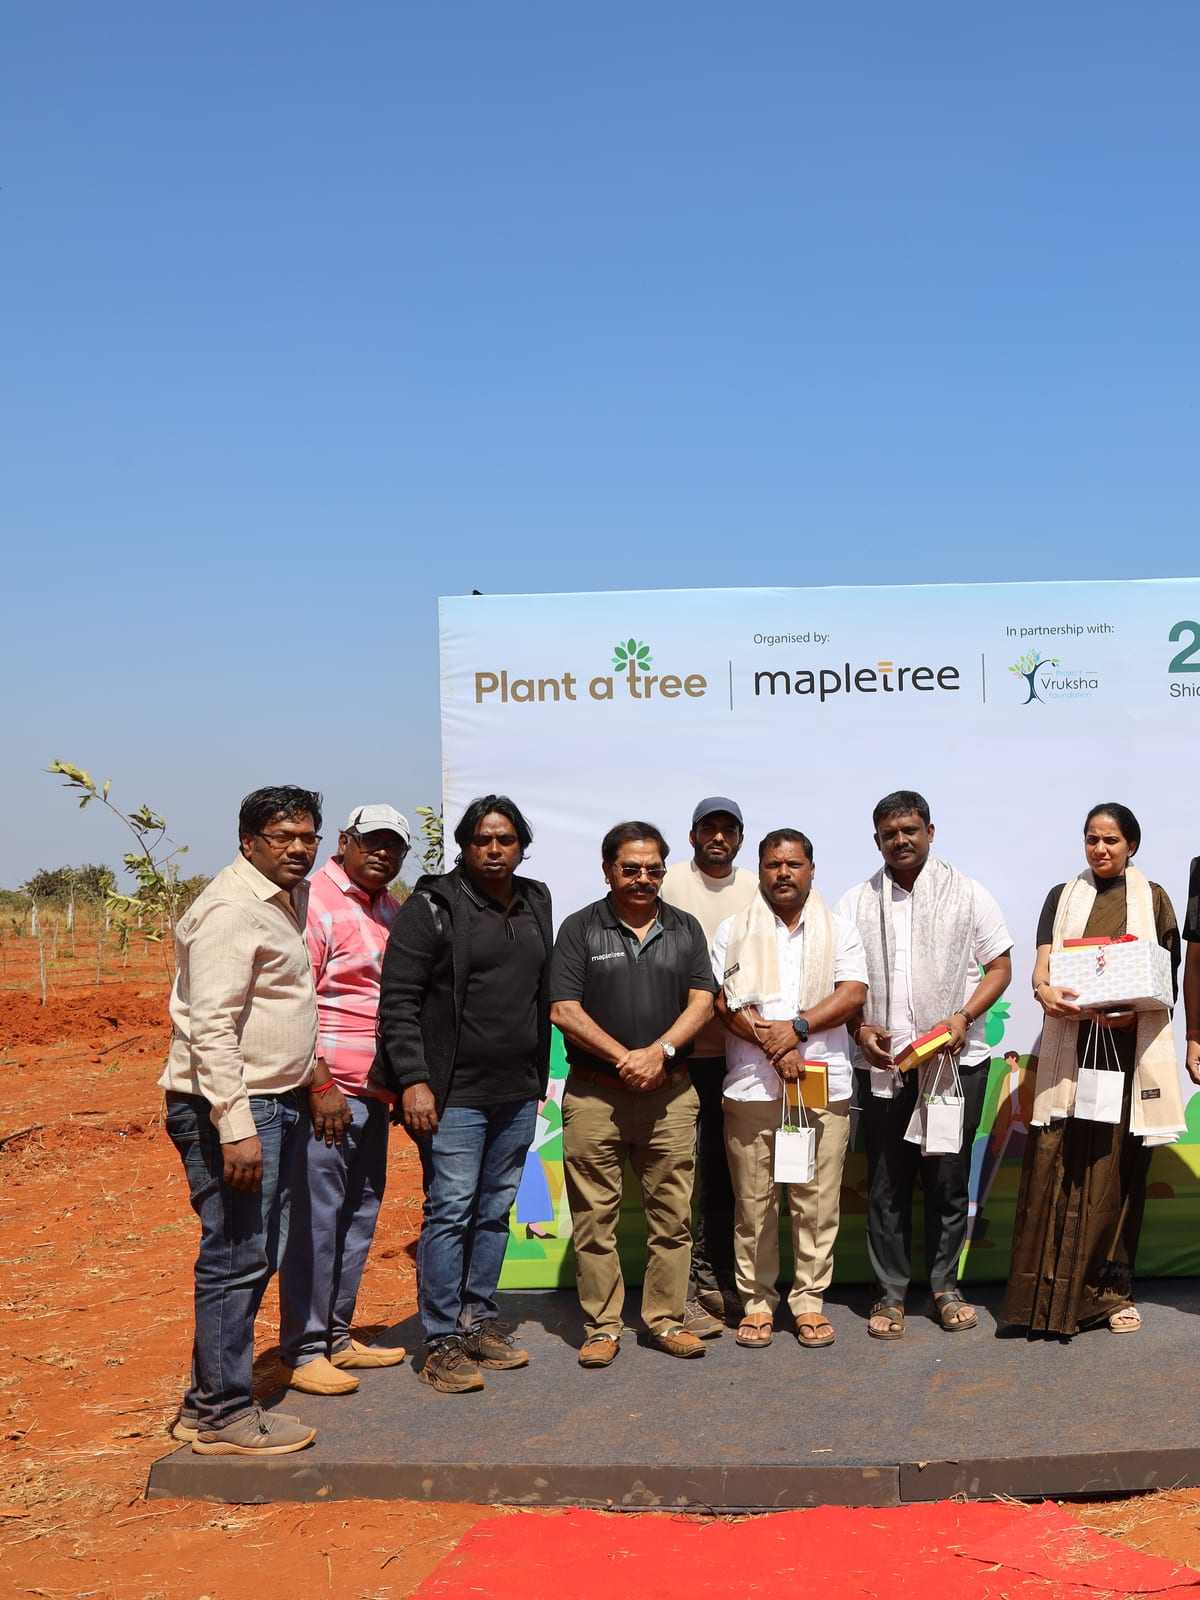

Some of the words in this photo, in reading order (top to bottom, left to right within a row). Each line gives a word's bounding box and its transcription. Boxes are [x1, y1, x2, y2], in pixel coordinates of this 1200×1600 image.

[1006, 626, 1017, 636] In
[1020, 624, 1084, 638] partnership
[1087, 623, 1114, 634] with:
[753, 632, 810, 646] Organised
[813, 632, 831, 644] by:
[475, 670, 577, 704] Plant
[589, 676, 613, 700] a
[626, 659, 707, 699] tree
[754, 661, 960, 702] mapletree
[1041, 677, 1098, 690] Vruksha
